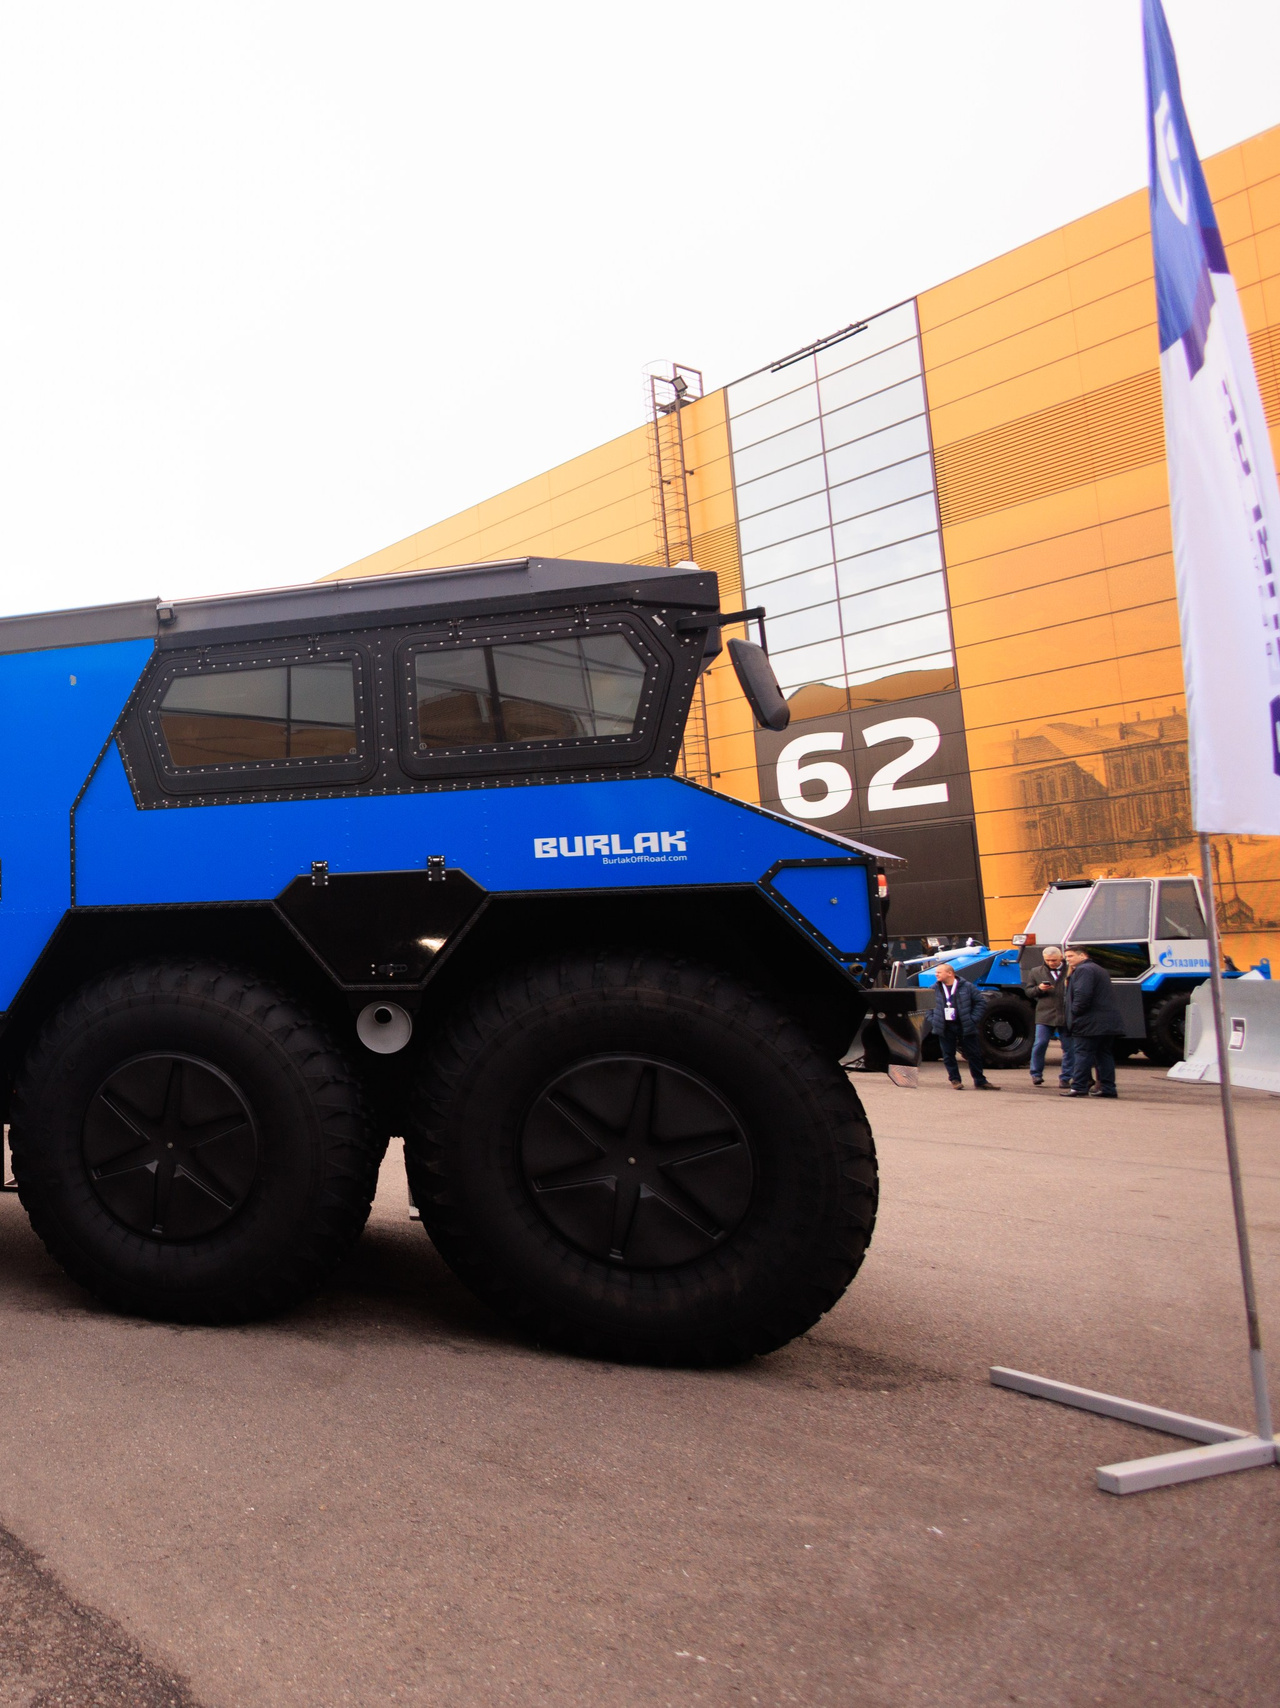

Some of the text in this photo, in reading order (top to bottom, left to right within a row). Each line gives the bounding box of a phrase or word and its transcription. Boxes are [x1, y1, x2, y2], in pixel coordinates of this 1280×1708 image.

[776, 716, 949, 819] 62
[534, 830, 687, 858] BURLAK
[602, 854, 688, 865] BurlakOffRoad.com
